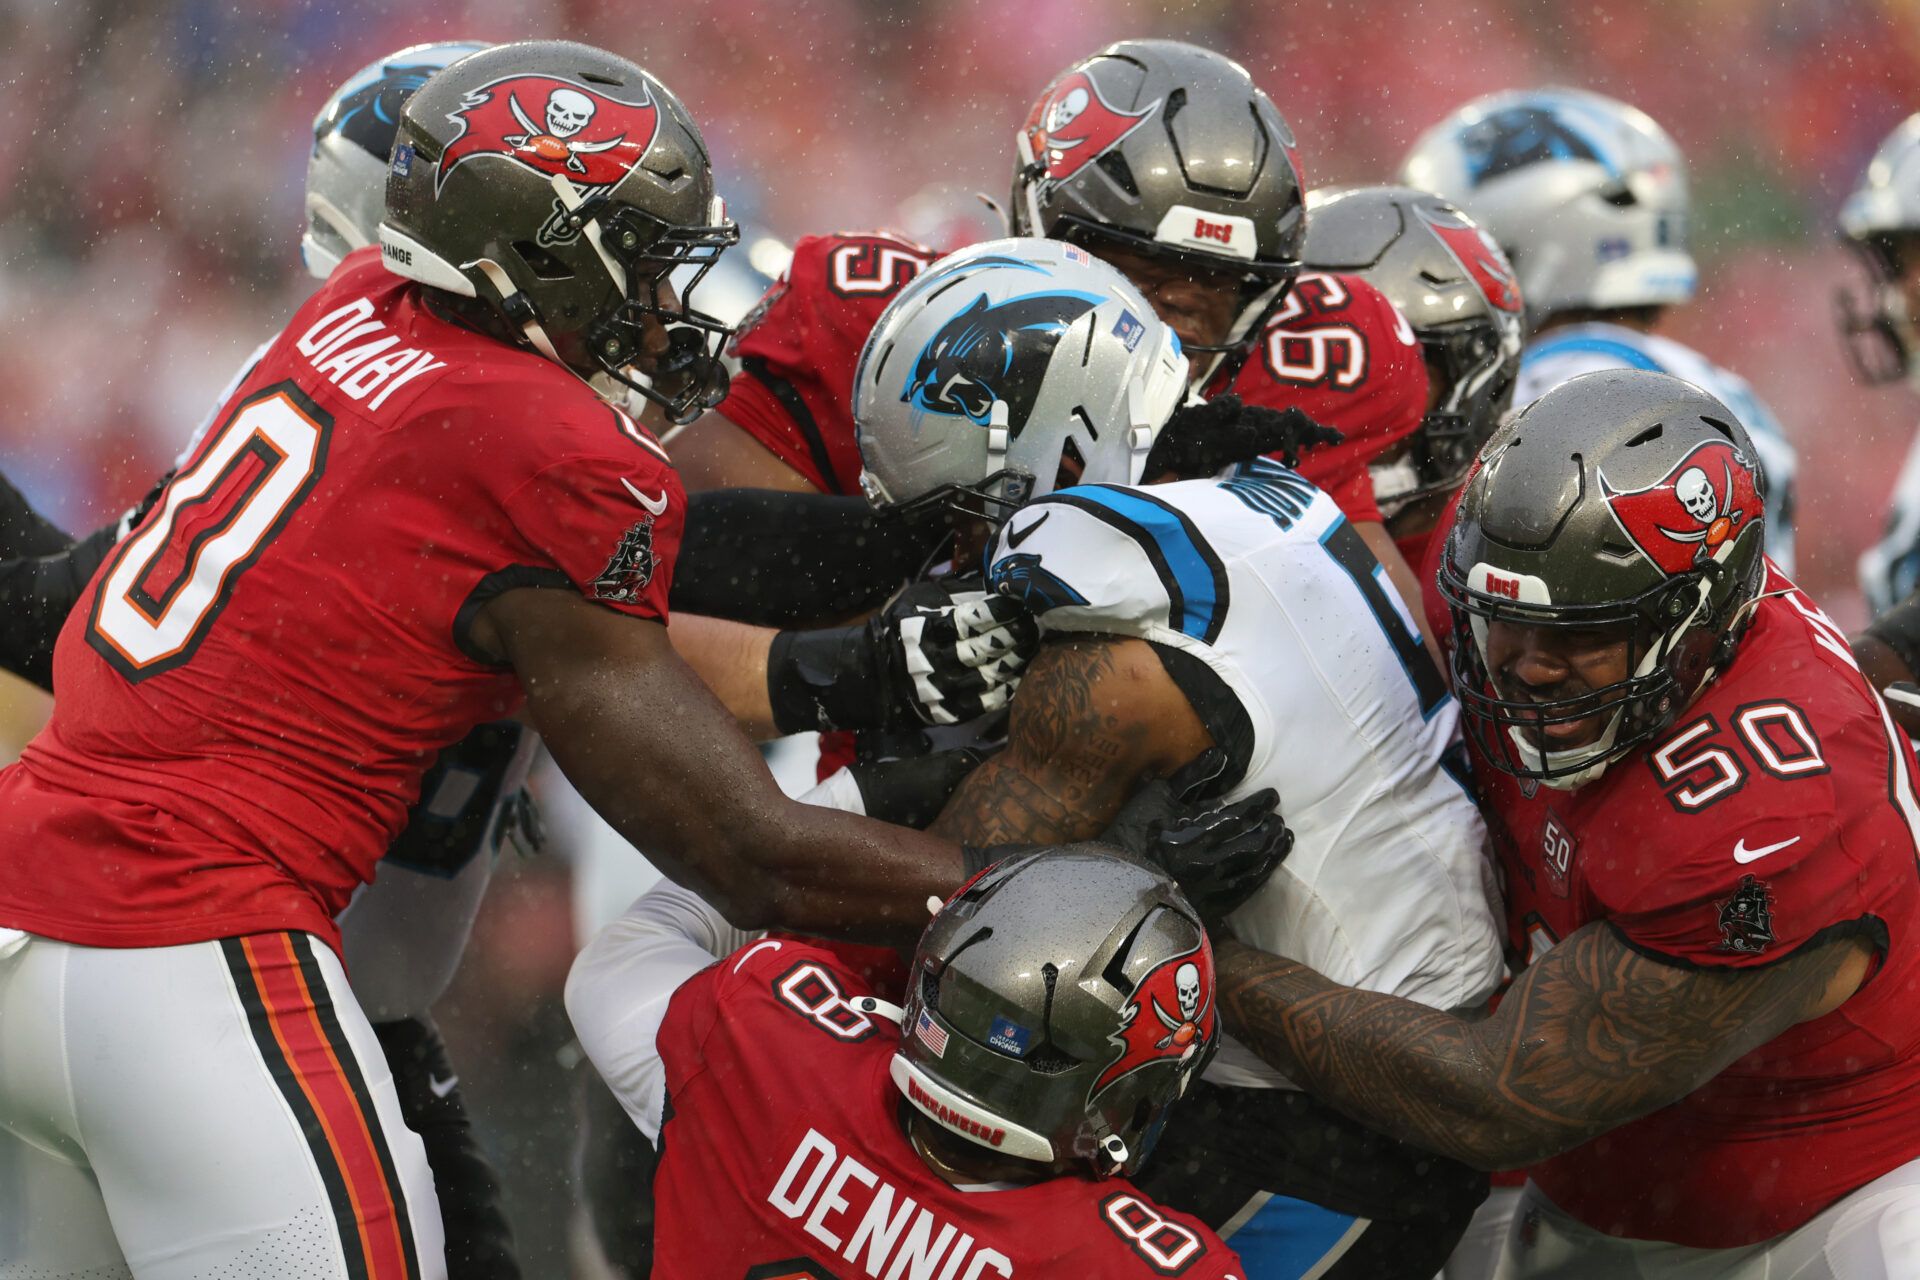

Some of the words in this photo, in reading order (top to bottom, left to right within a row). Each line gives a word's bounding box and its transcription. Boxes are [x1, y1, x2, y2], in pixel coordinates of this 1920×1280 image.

[296, 297, 447, 412] DIABY
[93, 388, 324, 670] 0
[1650, 703, 1827, 808] 50
[1544, 821, 1569, 872] 50
[778, 963, 875, 1040] 8
[908, 1075, 1005, 1147] BUCCANEERS
[1104, 1194, 1202, 1270] 8
